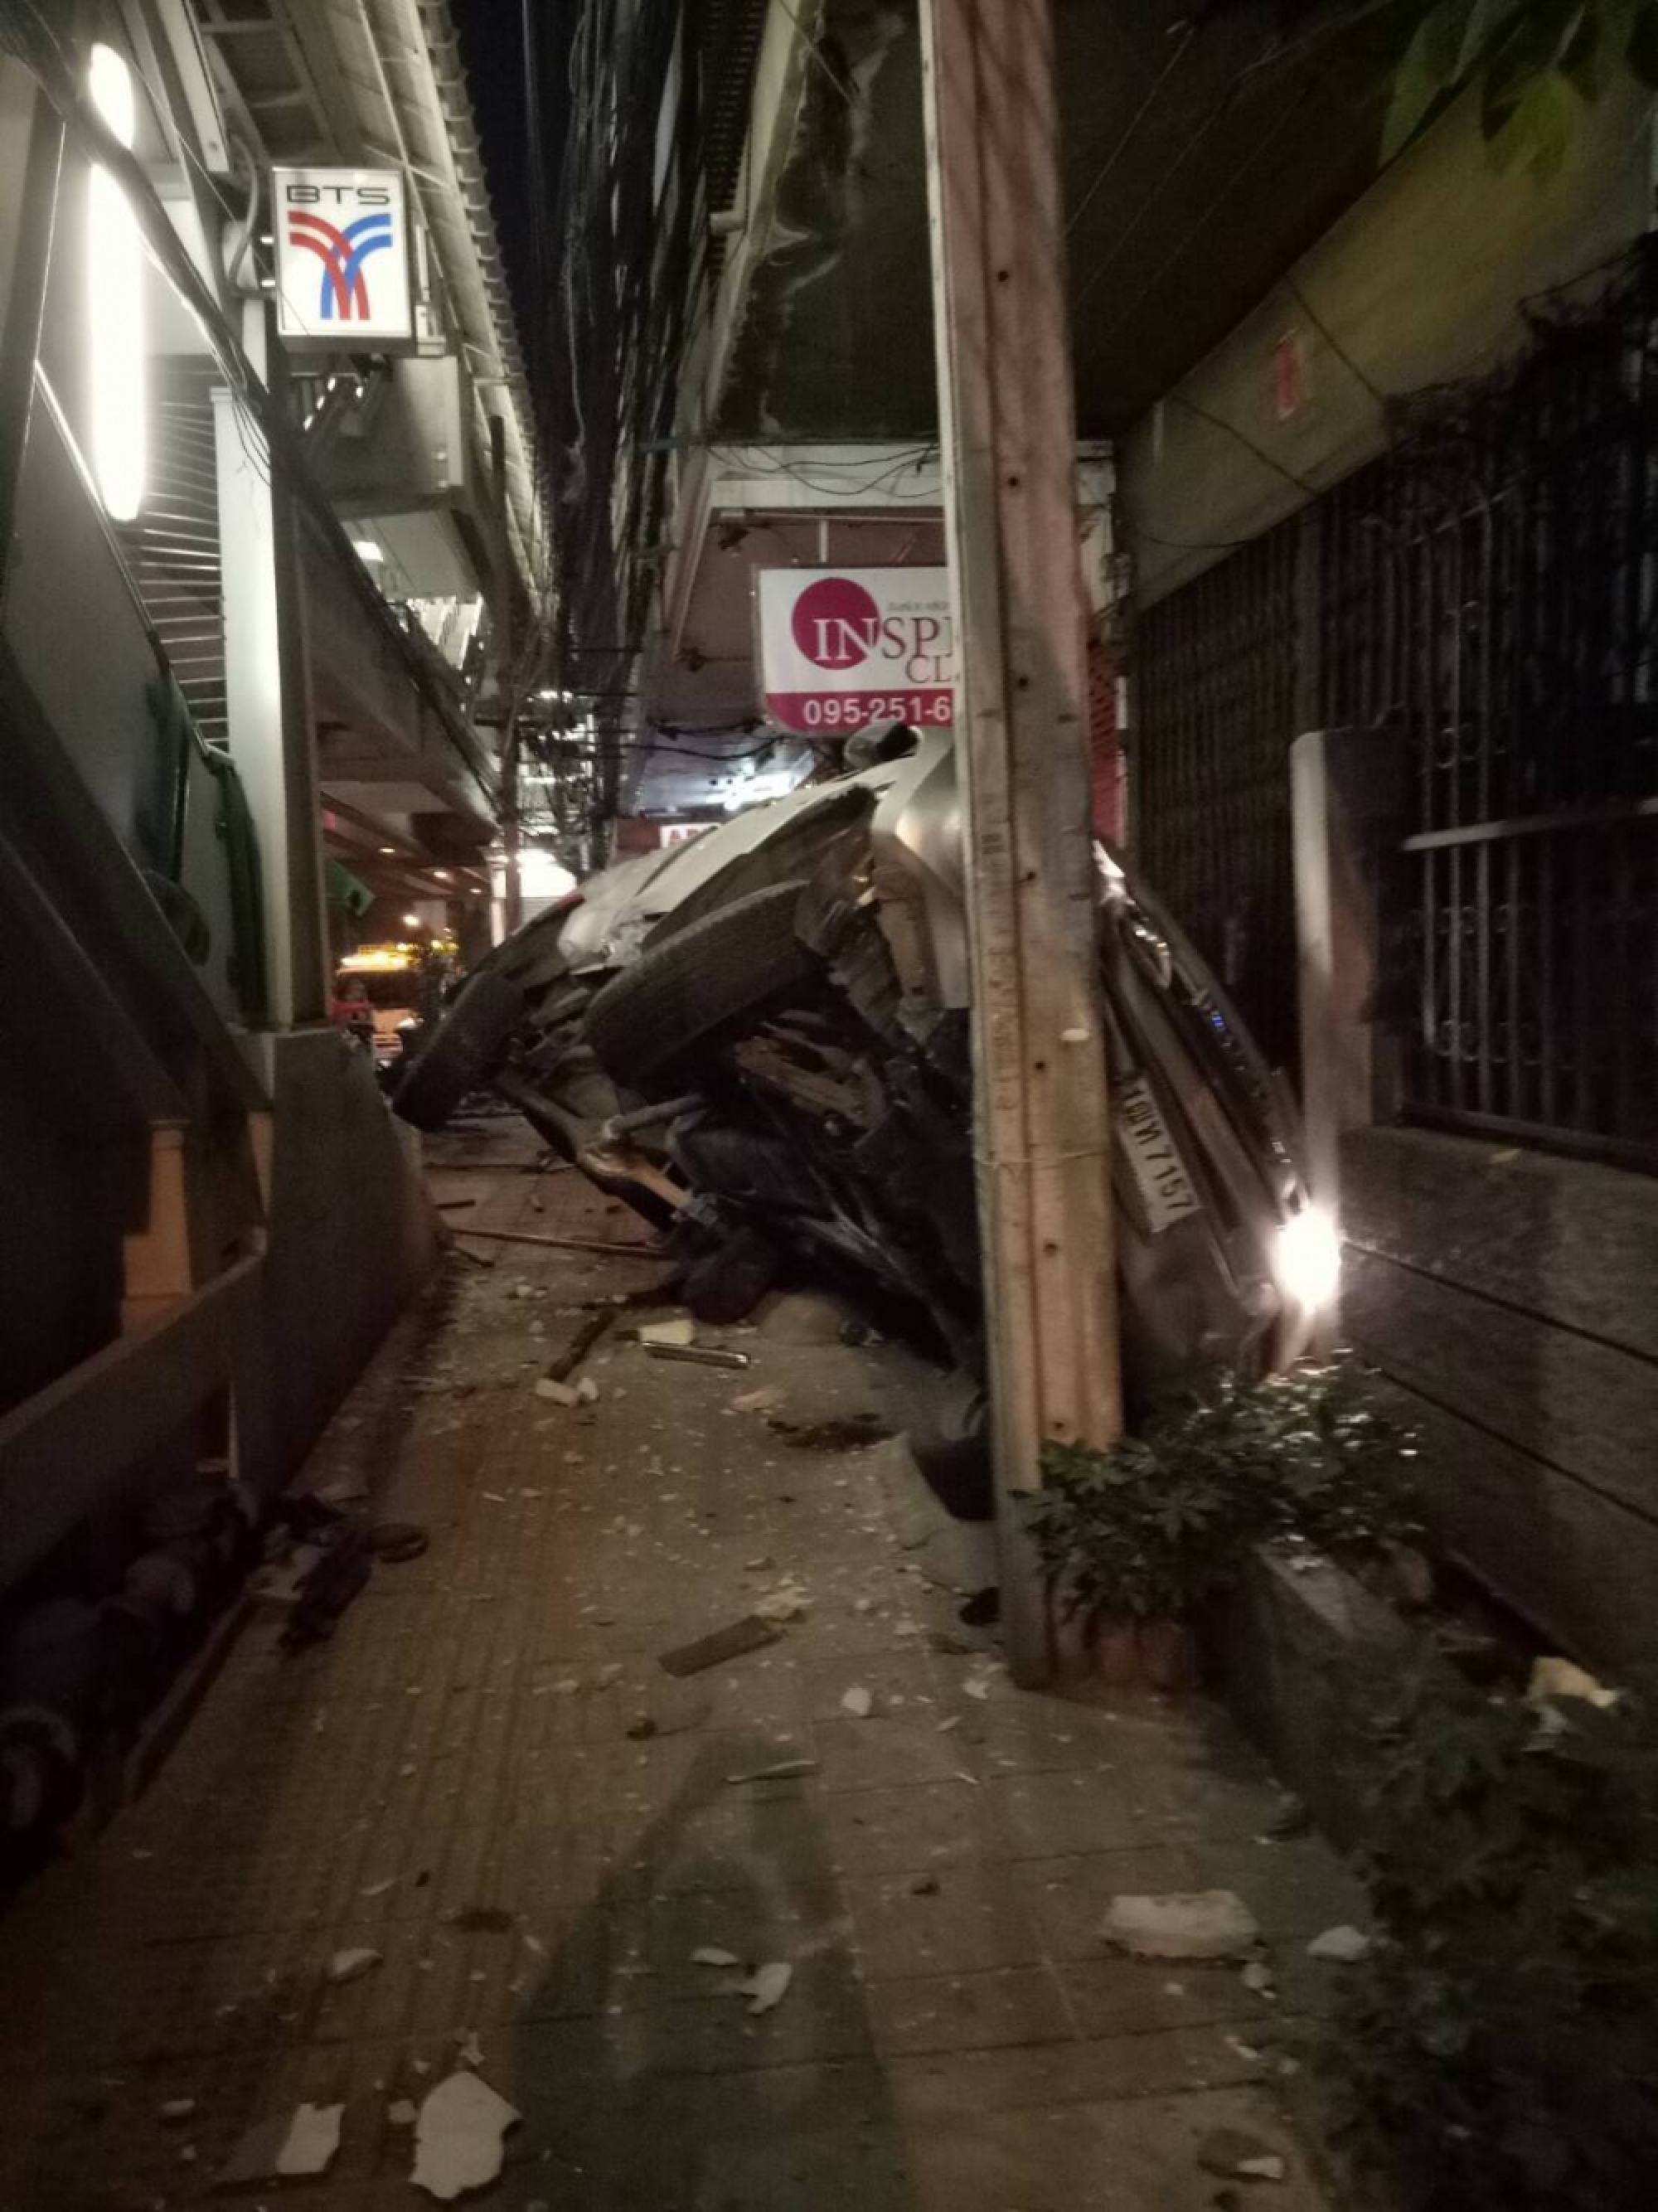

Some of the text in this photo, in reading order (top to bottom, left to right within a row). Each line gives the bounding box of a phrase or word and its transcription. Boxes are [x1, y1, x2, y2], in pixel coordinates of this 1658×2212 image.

[286, 185, 390, 205] BTS
[905, 655, 959, 683] CL
[1146, 1143, 1195, 1210] 7157
